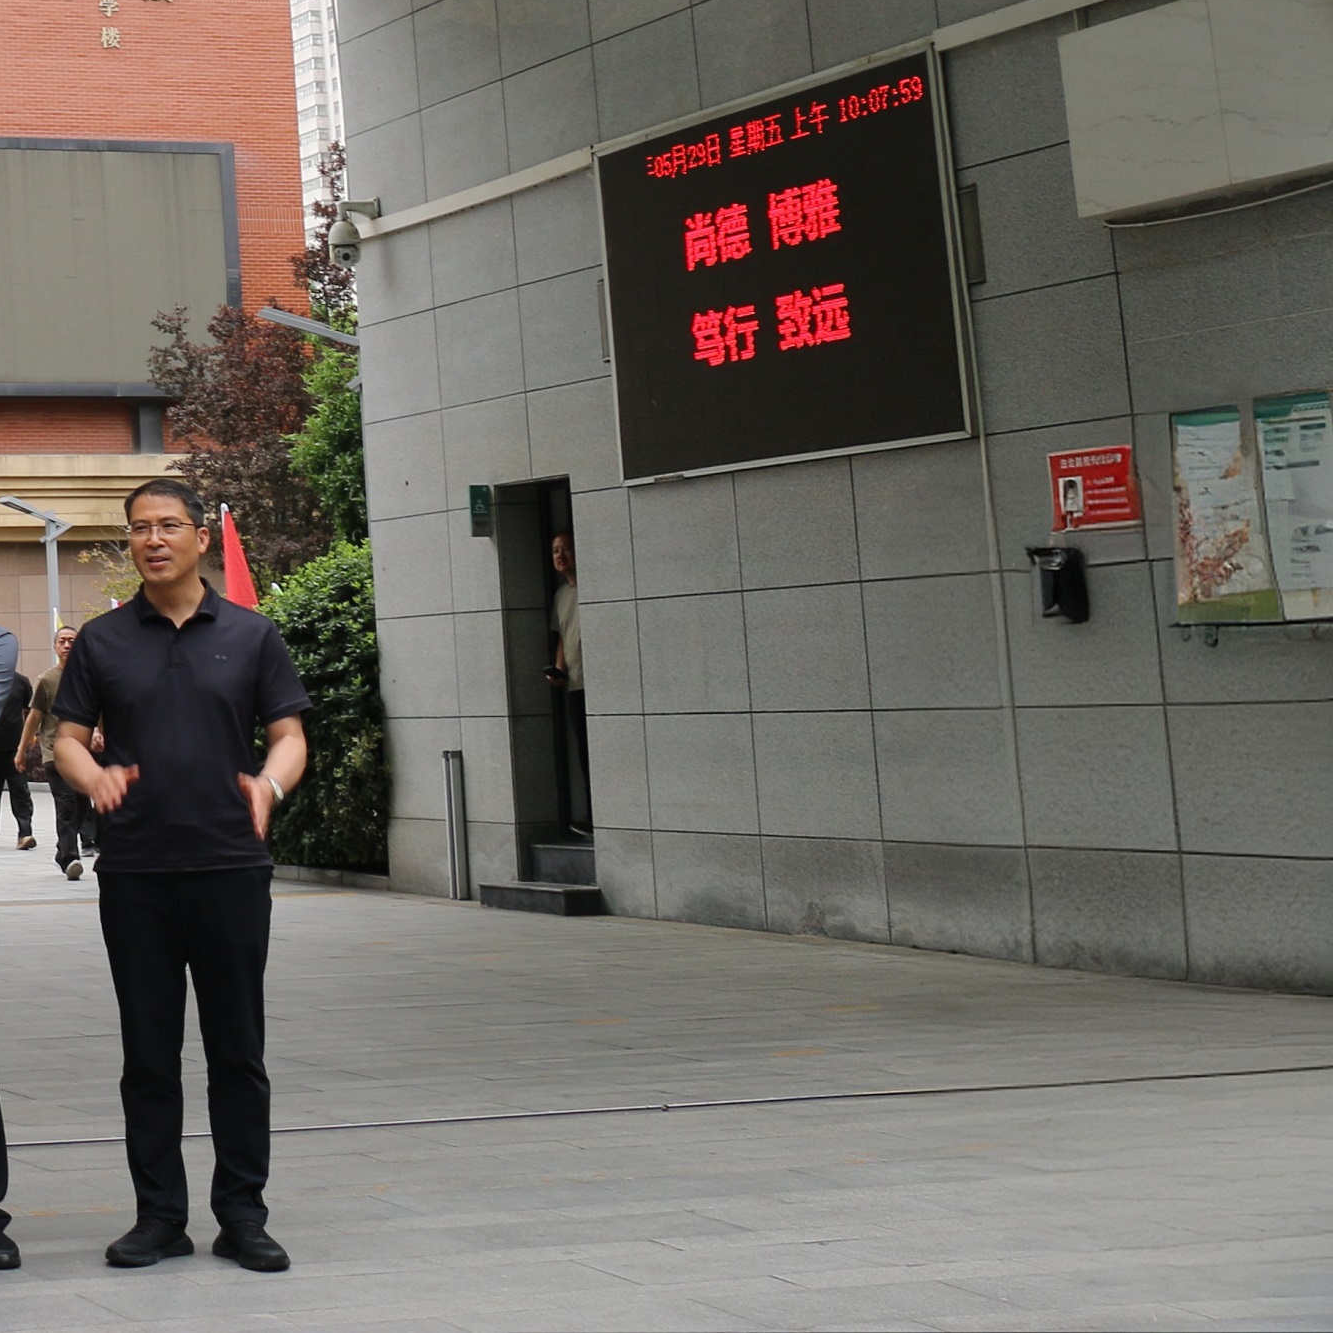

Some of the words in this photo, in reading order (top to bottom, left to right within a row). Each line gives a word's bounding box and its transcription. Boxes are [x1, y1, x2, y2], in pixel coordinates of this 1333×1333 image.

[729, 114, 785, 158] 星期五
[789, 101, 830, 140] 上午
[837, 76, 924, 123] 10:07:59
[683, 202, 753, 272] 尚德
[767, 178, 842, 250] 博雅
[690, 304, 760, 368] 笃行
[774, 283, 852, 351] 致远
